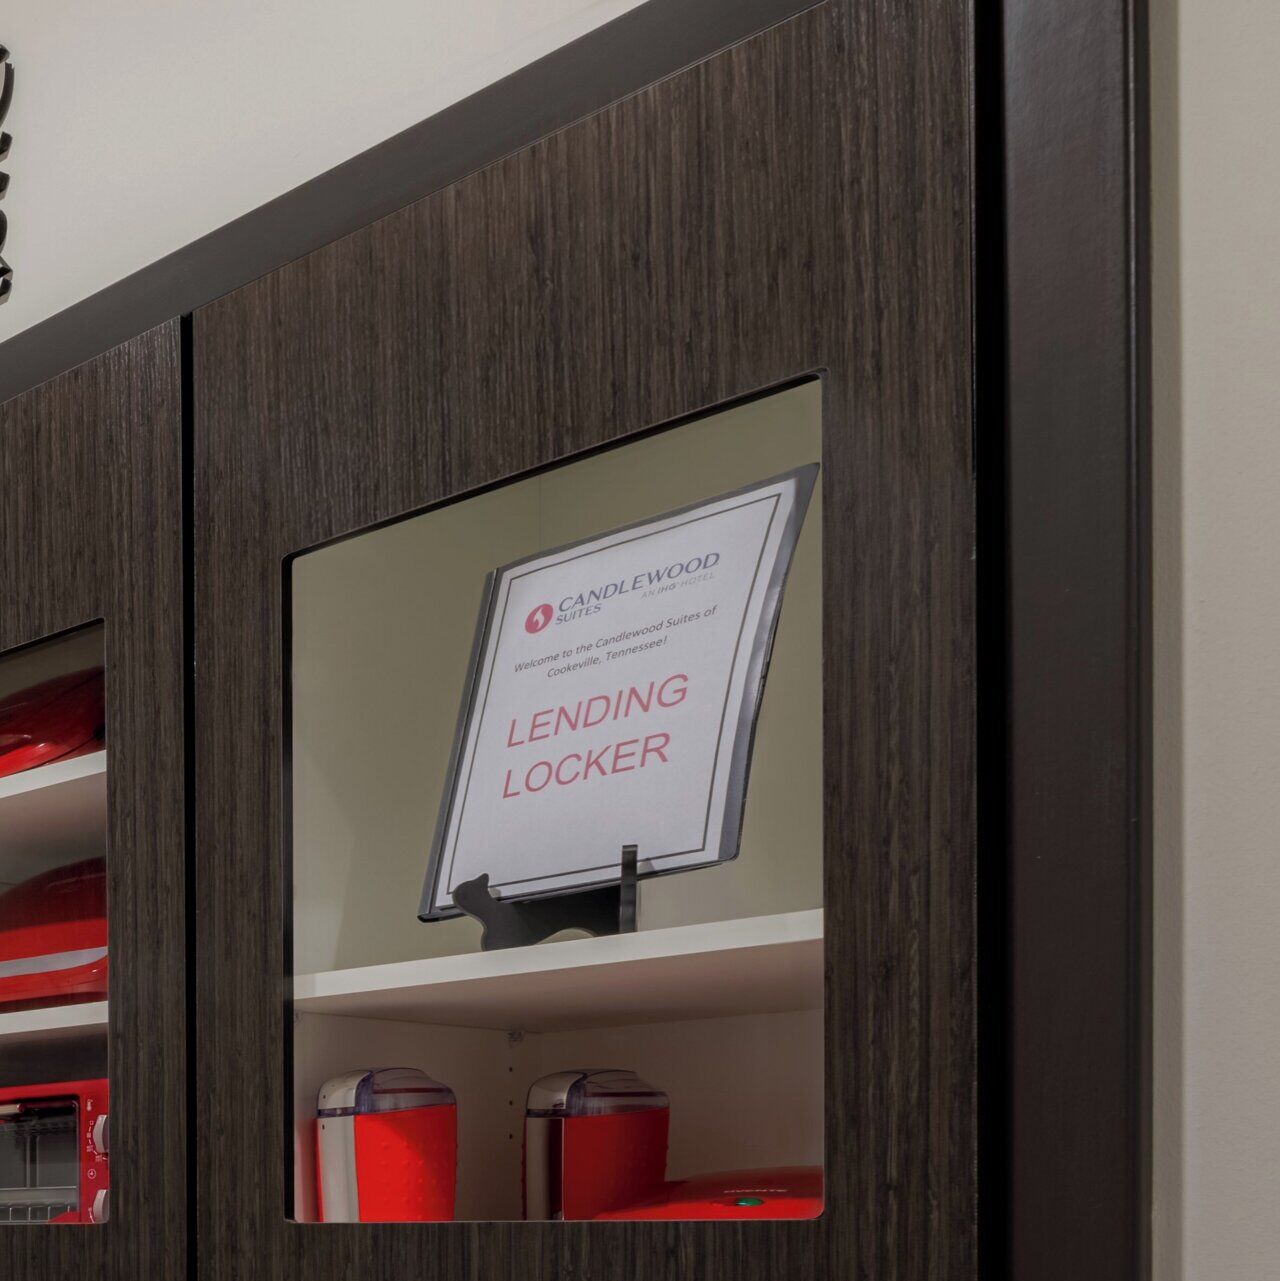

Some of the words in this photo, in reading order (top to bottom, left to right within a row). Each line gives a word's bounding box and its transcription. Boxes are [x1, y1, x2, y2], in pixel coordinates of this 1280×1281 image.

[555, 603, 602, 625] SUITES
[559, 552, 720, 613] CANDLEWOOD
[514, 653, 560, 673] Welcome
[562, 648, 573, 658] to
[576, 642, 593, 656] the
[595, 620, 664, 648] Candlewood
[666, 611, 701, 629] Suites
[704, 604, 718, 617] of
[547, 656, 602, 678] Cookeville,
[606, 635, 668, 661] Tennessee!
[507, 673, 689, 749] LENDING
[502, 732, 671, 800] LOCKER
